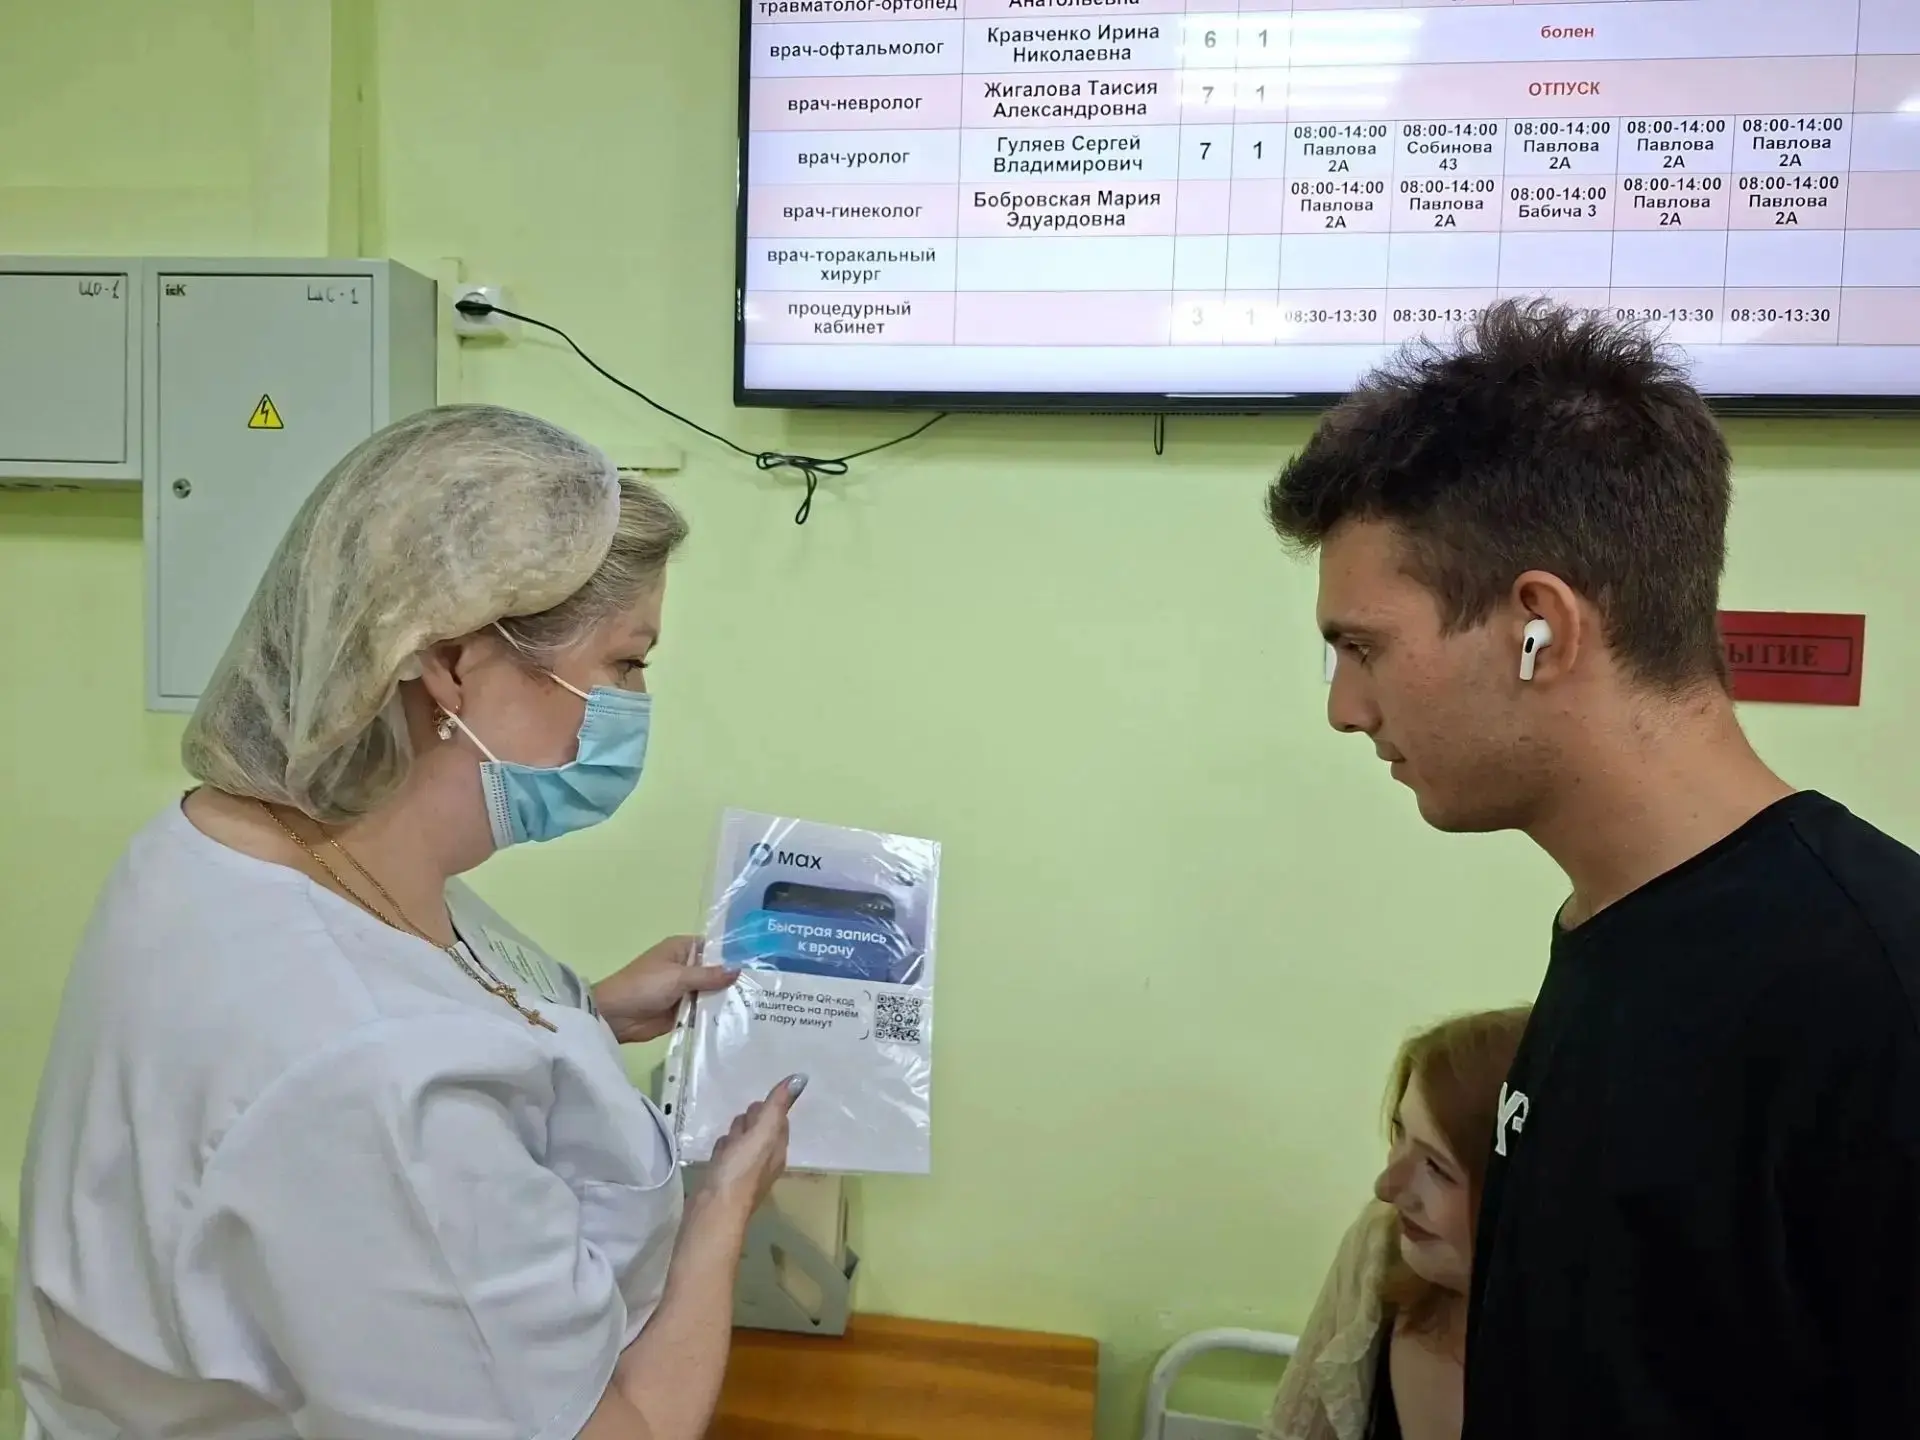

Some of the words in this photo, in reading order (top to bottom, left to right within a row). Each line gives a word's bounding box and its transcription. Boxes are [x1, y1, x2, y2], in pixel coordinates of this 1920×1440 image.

[759, 0, 958, 16] травматолог-ортопед
[987, 26, 1091, 46] Кравченко
[1098, 24, 1160, 43] Ирина
[1258, 29, 1268, 48] 1
[1540, 24, 1595, 39] болен
[1204, 30, 1217, 48] 6
[770, 41, 945, 60] врач-офтальмолог
[1013, 47, 1131, 63] Николаевна
[984, 82, 1081, 98] Жигалова
[1087, 80, 1158, 96] Таисия
[1202, 86, 1215, 105] 7
[1256, 85, 1265, 104] 1
[1528, 81, 1601, 96] ОТПУСК
[788, 97, 923, 114] врач-невролог
[993, 102, 1147, 119] Александровна
[1294, 125, 1388, 139] 08:00-14:00
[1403, 123, 1498, 137] 08:00-14:00
[1514, 121, 1611, 135] 08:00-14:00
[1627, 120, 1726, 134] 08:00-14:00
[1743, 118, 1843, 132] 08:00-14:00
[997, 137, 1065, 154] Гуляев
[1072, 135, 1141, 153] Сергей
[1253, 141, 1263, 159] 1
[1304, 143, 1377, 156] Павлова
[1407, 141, 1493, 154] Собинова
[1524, 139, 1600, 153] Павлова
[1637, 138, 1714, 151] Павлова
[1753, 136, 1831, 150] Павлова
[798, 149, 910, 166] врач-уролог
[1200, 142, 1212, 160] 7
[994, 156, 1143, 174] Владимирович
[1328, 160, 1350, 173] 2А
[1439, 158, 1458, 171] 43
[1549, 156, 1571, 169] 2А
[1663, 155, 1685, 168] 2А
[1779, 153, 1802, 167] 2А
[1291, 181, 1385, 195] 08:00-14:00
[1400, 180, 1495, 194] 08:00-14:00
[1623, 177, 1722, 191] 08:00-14:00
[1739, 176, 1839, 190] 08:00-14:00
[974, 191, 1091, 208] Бобровская
[1097, 190, 1161, 208] Мария
[1510, 187, 1607, 200] 08:00-14:00
[1301, 199, 1374, 212] Павлова
[1409, 198, 1484, 211] Павлова
[1634, 196, 1711, 209] Павлова
[1749, 195, 1828, 208] Павлова
[783, 203, 923, 219] врач-гинеколог
[1518, 204, 1582, 218] Бабича
[1588, 204, 1597, 217] 3
[1775, 211, 1798, 225] 2А
[1006, 211, 1126, 230] Эдуардовна
[1325, 216, 1347, 229] 2А
[1434, 214, 1456, 227] 2А
[1659, 212, 1682, 226] 2А
[767, 247, 936, 265] врач-торакальный
[820, 269, 882, 284] хирург
[788, 301, 911, 319] процедурный
[1192, 307, 1204, 326] 3
[1246, 308, 1255, 325] 1
[1285, 309, 1377, 323] 08:30-13:30
[1616, 308, 1714, 322] 08:30-13:30
[1731, 308, 1831, 322] 08:30-13:30
[814, 320, 885, 335] кабинет
[1728, 643, 1820, 666] ЫТИЕ
[767, 919, 832, 938] Быстрая
[835, 929, 887, 945] запись
[798, 941, 806, 951] к
[809, 942, 855, 959] врачу
[816, 993, 855, 1007] QR-код
[808, 1006, 822, 1015] на
[824, 1007, 859, 1018] приём
[753, 1012, 767, 1021] за
[770, 1013, 797, 1027] пару
[800, 1018, 833, 1030] минут
